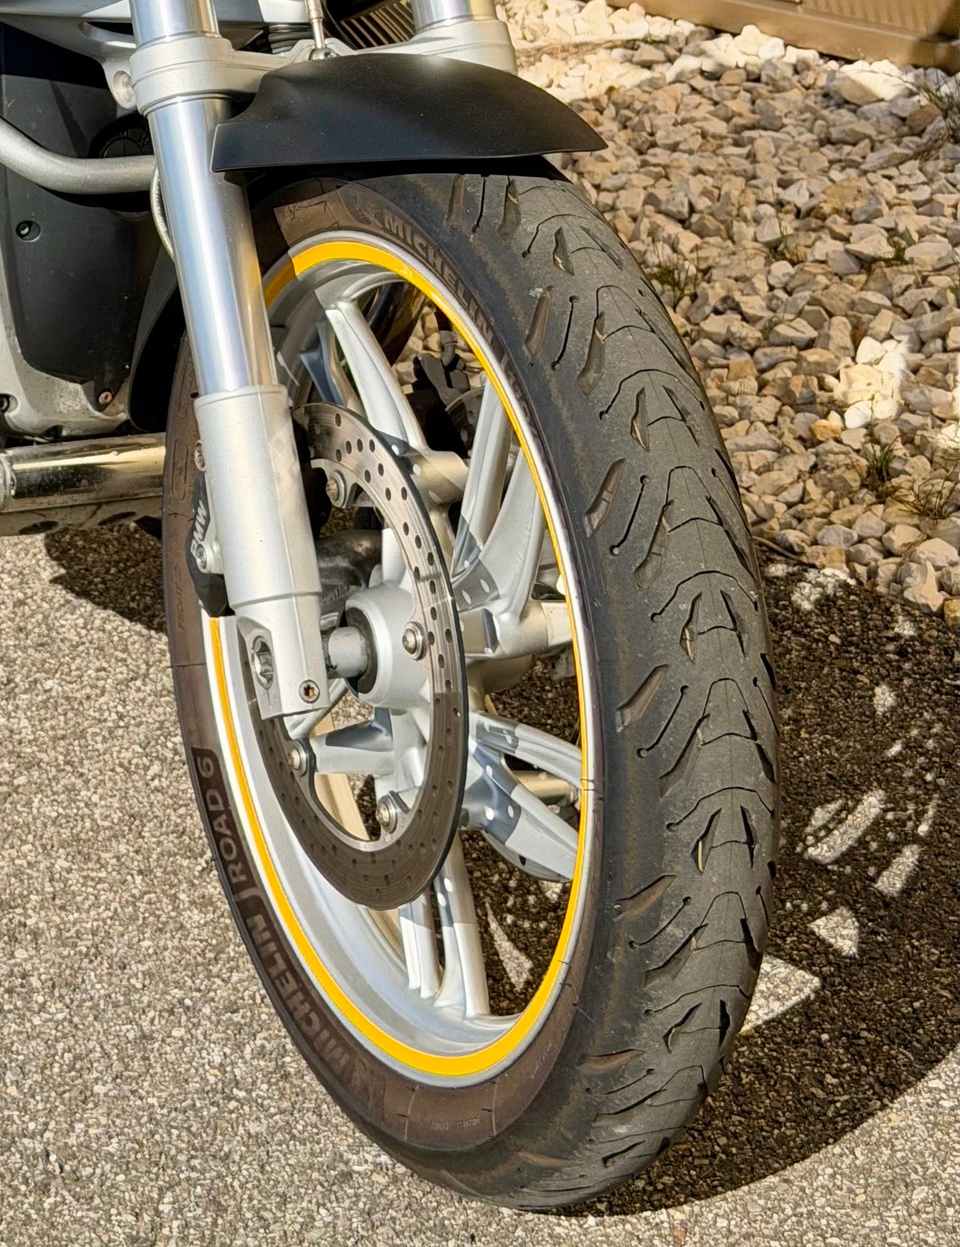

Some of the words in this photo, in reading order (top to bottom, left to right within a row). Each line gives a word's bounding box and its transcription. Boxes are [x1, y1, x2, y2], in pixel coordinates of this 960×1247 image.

[196, 755, 216, 779] 6
[205, 787, 248, 885] ROAD
[246, 913, 351, 1075] MICHELIN
